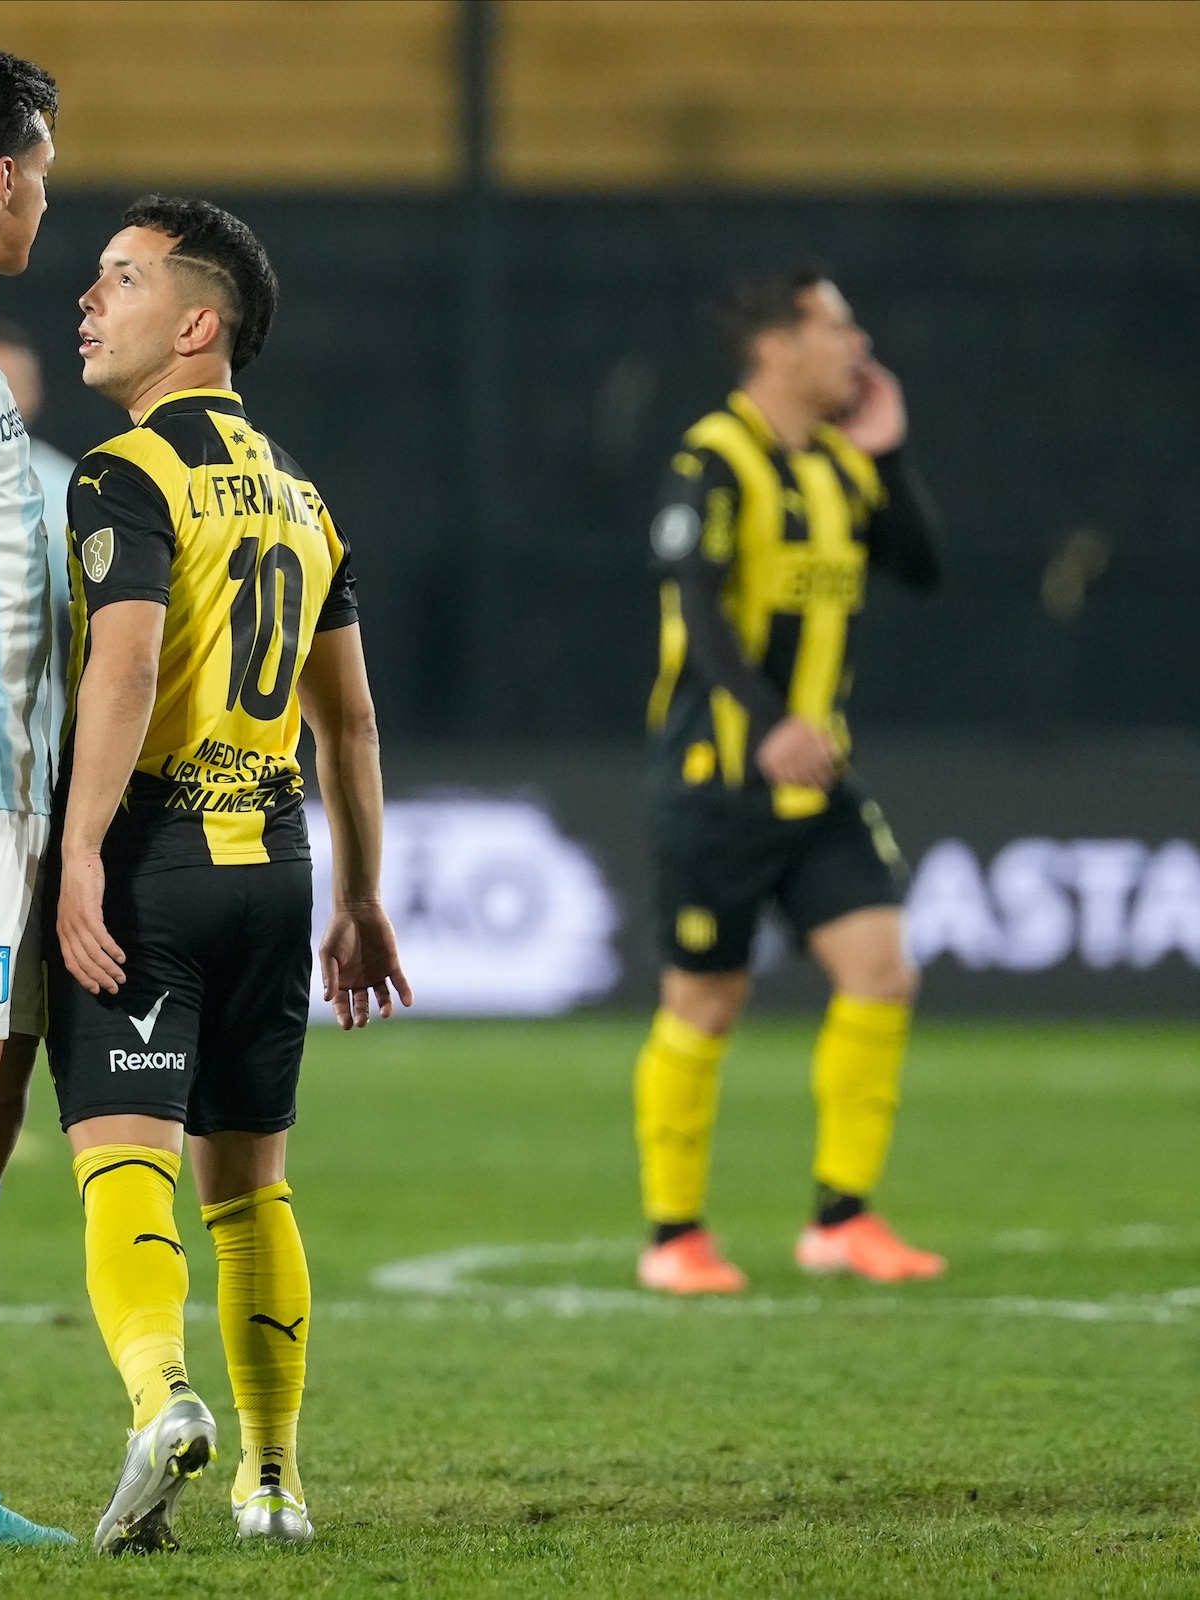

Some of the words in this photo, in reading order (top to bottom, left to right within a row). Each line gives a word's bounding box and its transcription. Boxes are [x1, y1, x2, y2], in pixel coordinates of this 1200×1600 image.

[188, 480, 210, 518] L.
[211, 473, 326, 535] FERNNDEZ
[226, 536, 305, 721] 10
[161, 754, 289, 783] URUGUAY
[902, 837, 1200, 970] ASTA
[109, 1049, 185, 1072] Rexona
